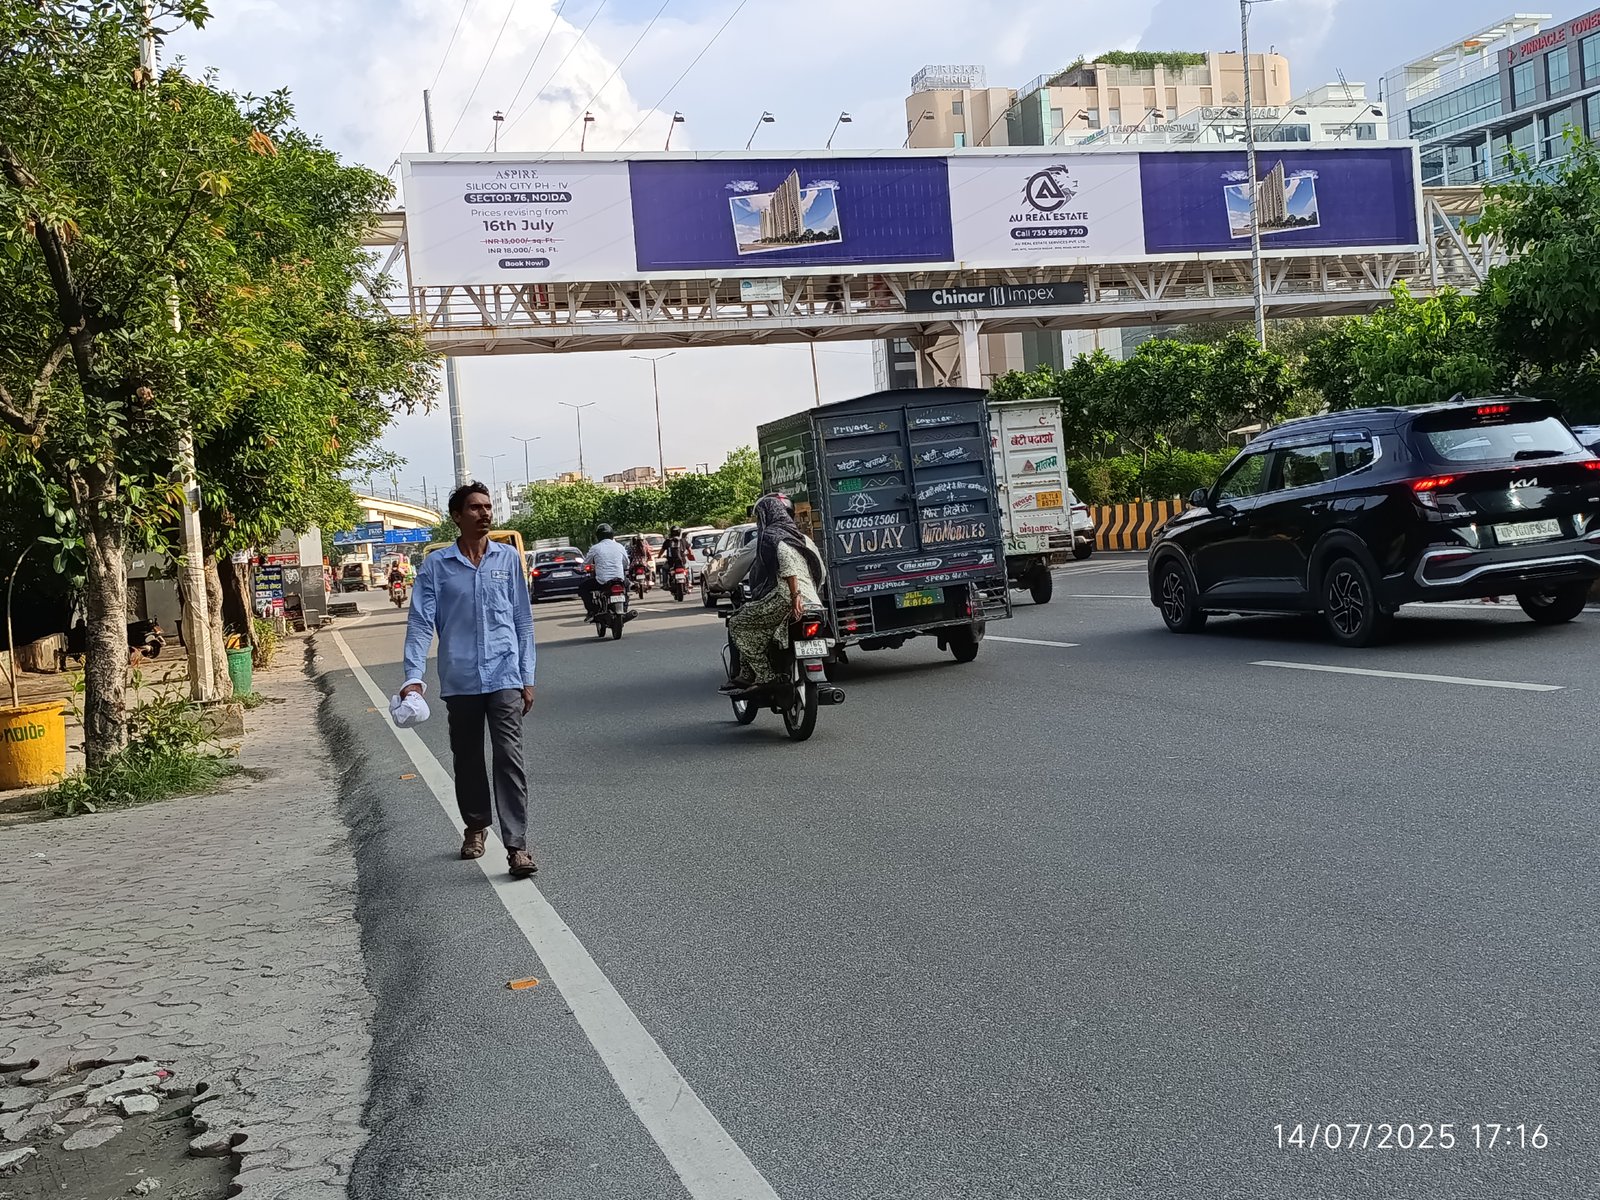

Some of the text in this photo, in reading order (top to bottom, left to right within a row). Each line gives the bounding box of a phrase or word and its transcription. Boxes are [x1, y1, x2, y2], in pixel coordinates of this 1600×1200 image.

[1520, 28, 1565, 57] PINNACLE
[496, 170, 538, 179] ASPIRE
[470, 193, 567, 203] SECTOR 76, NOIDA
[504, 208, 542, 217] revising
[1009, 212, 1088, 222] AU REAL ESTATE
[483, 219, 554, 233] 16th July
[932, 287, 1054, 304] Chinar Impex
[1509, 477, 1538, 489] KIA
[838, 525, 905, 554] VIJAY
